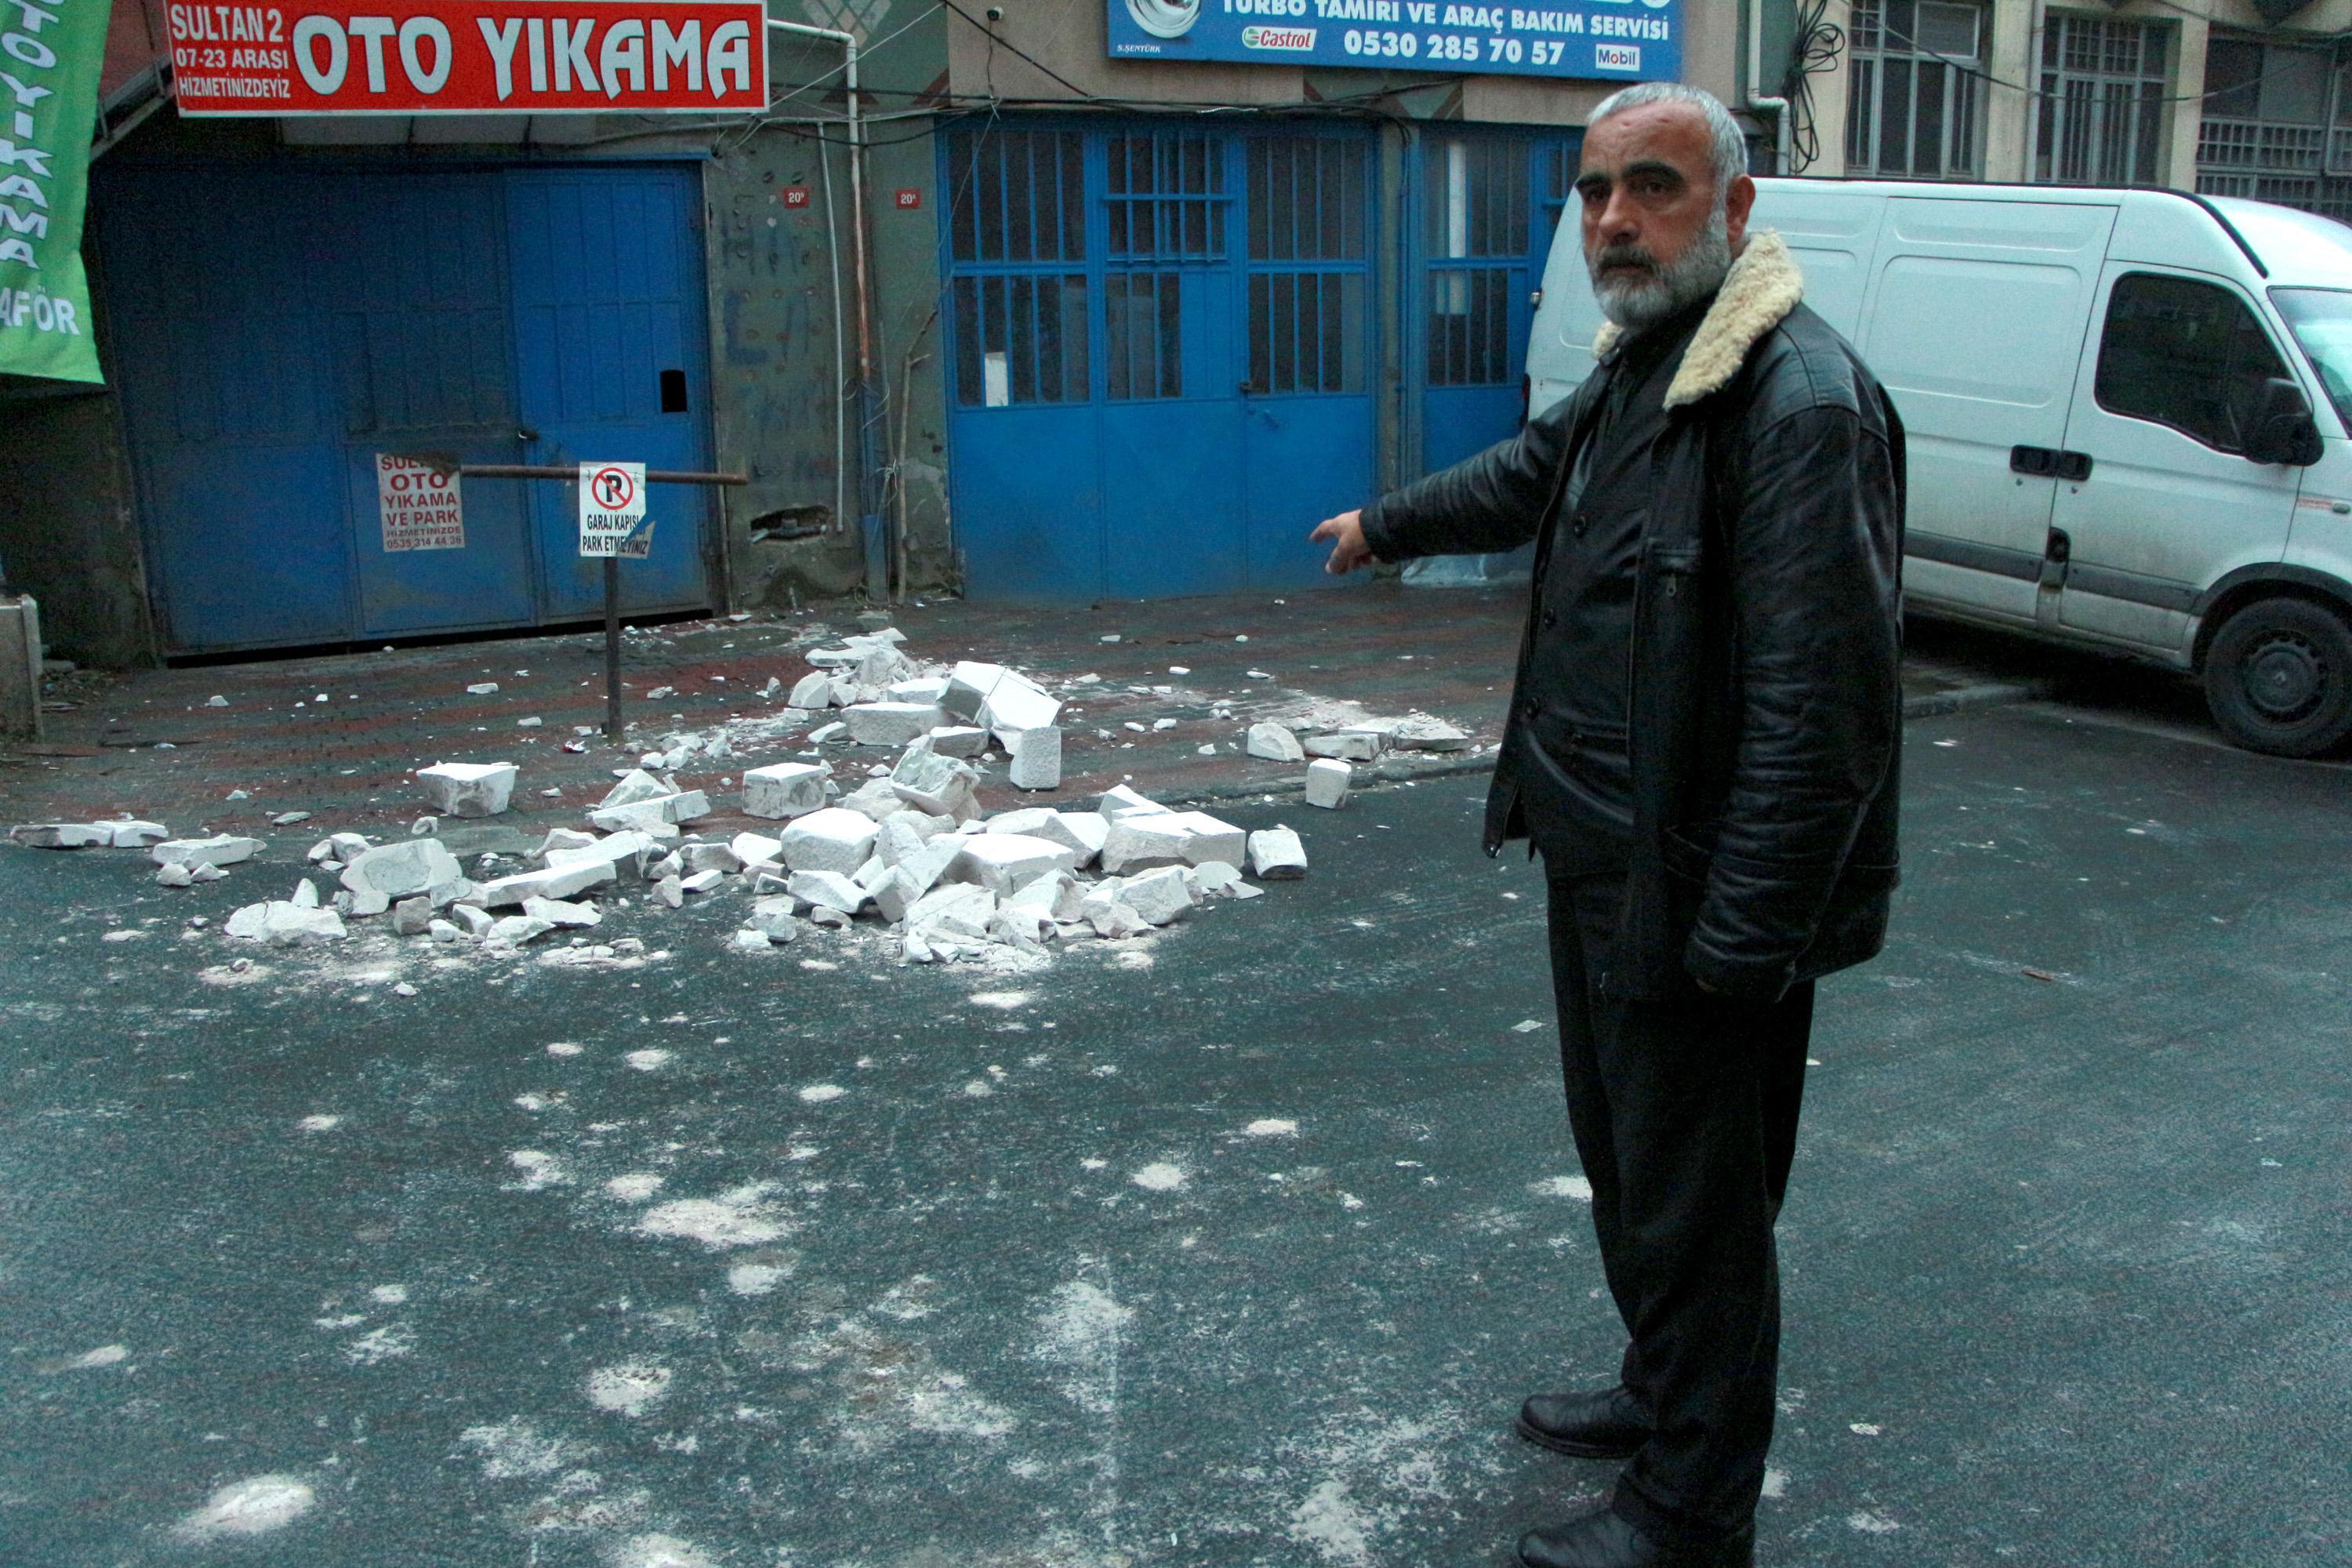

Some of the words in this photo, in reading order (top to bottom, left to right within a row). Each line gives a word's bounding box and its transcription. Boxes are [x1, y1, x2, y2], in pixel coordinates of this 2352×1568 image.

[171, 4, 264, 42] SULTAN
[267, 9, 283, 42] 2
[1407, 2, 1436, 24] VE
[1443, 5, 1504, 33] ARAÇ
[1511, 9, 1584, 34] BAKIM
[1590, 13, 1669, 41] SERVİSİ
[1, 0, 64, 69] TO
[1259, 30, 1312, 48] Castrol
[292, 15, 452, 95] OTO
[476, 17, 750, 102] YIKAMA
[1344, 30, 1417, 57] 0530
[1426, 34, 1479, 61] 285
[1490, 38, 1523, 63] 70
[1531, 42, 1566, 65] 57
[1599, 49, 1636, 66] Mobil
[176, 48, 227, 68] 07-23
[232, 49, 289, 70] ARASI
[178, 71, 292, 98] HİZMETİNİZDEYİZ
[0, 71, 54, 270] YIKAMA
[390, 471, 448, 492] OTO
[384, 492, 458, 510] YIKAMA
[386, 513, 408, 527] VE
[413, 510, 459, 525] PARK
[587, 514, 613, 531] GARAJ
[583, 535, 602, 551] PARK
